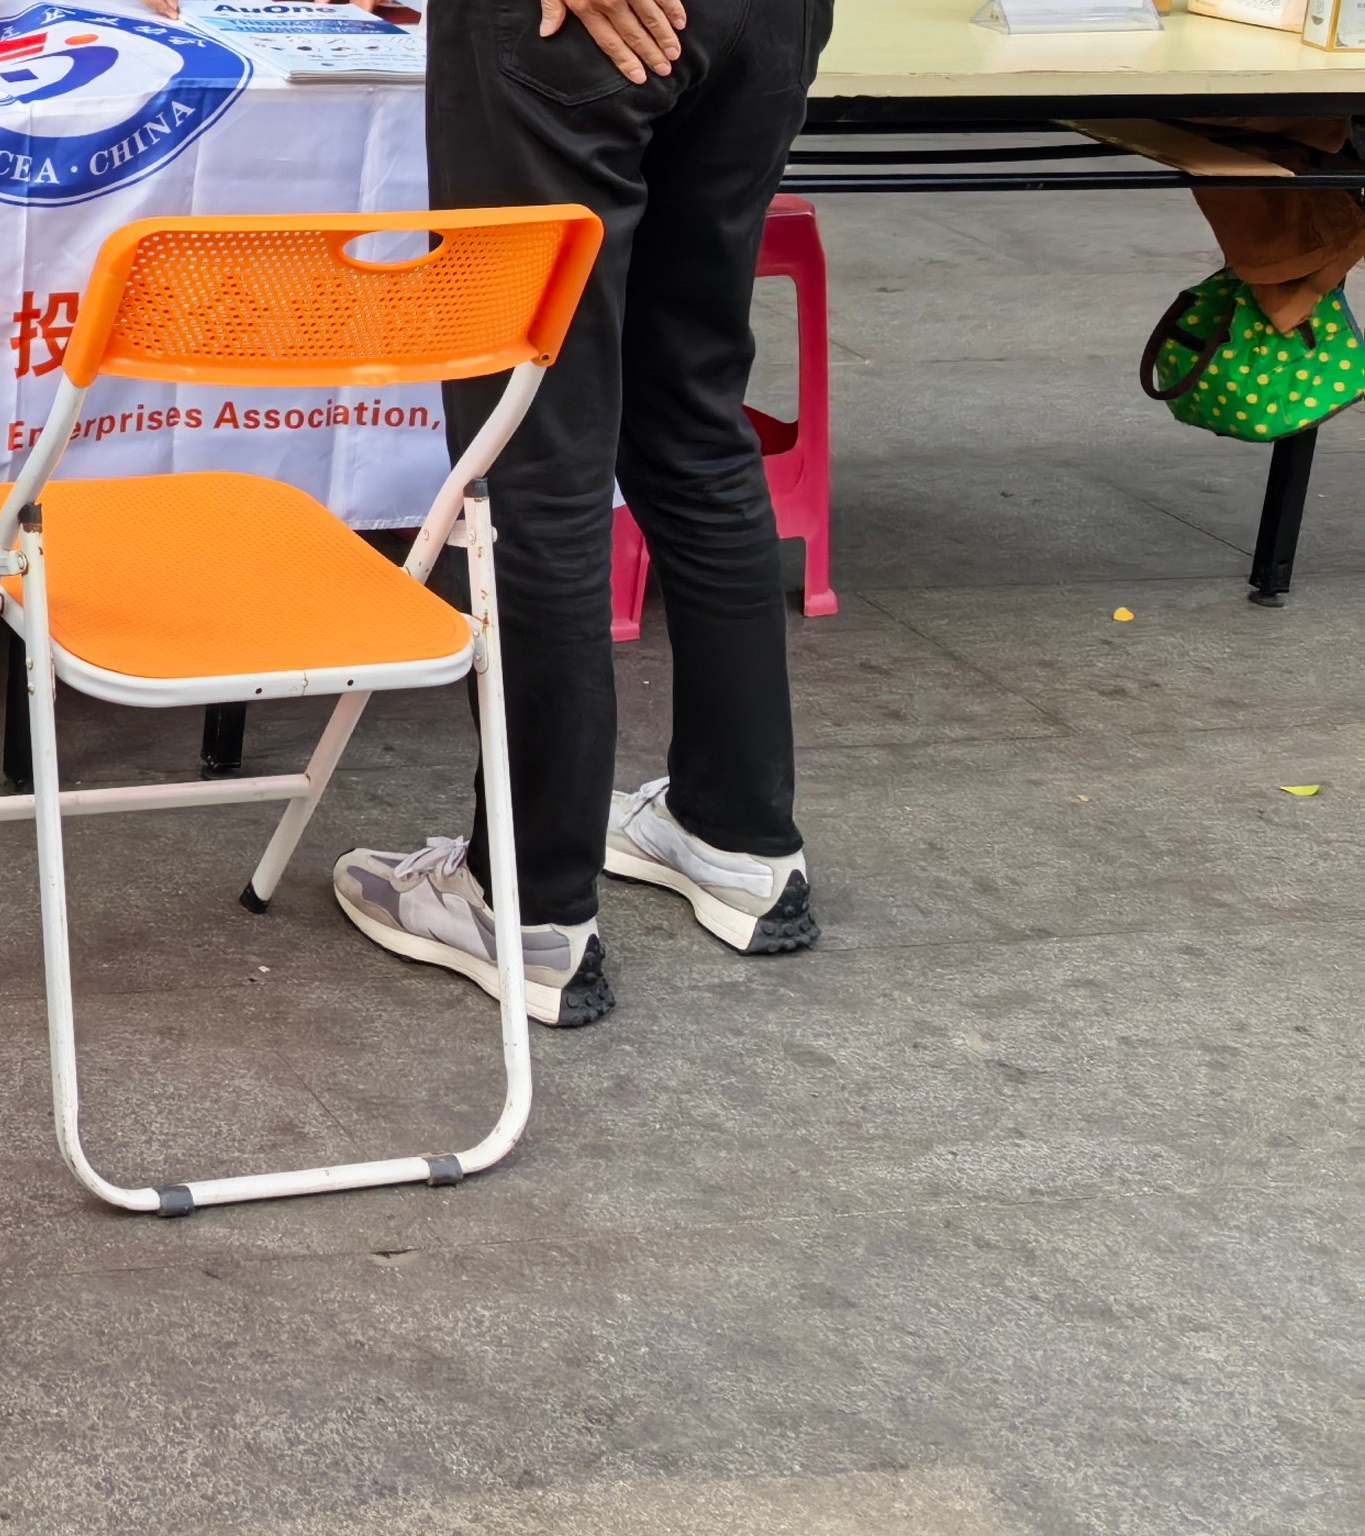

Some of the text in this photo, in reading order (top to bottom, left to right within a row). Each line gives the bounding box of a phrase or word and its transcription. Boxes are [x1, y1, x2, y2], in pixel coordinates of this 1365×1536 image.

[213, 4, 338, 14] AuOne
[89, 100, 197, 176] CHINA
[8, 402, 203, 451] Enerprises
[214, 398, 443, 430] Association,
